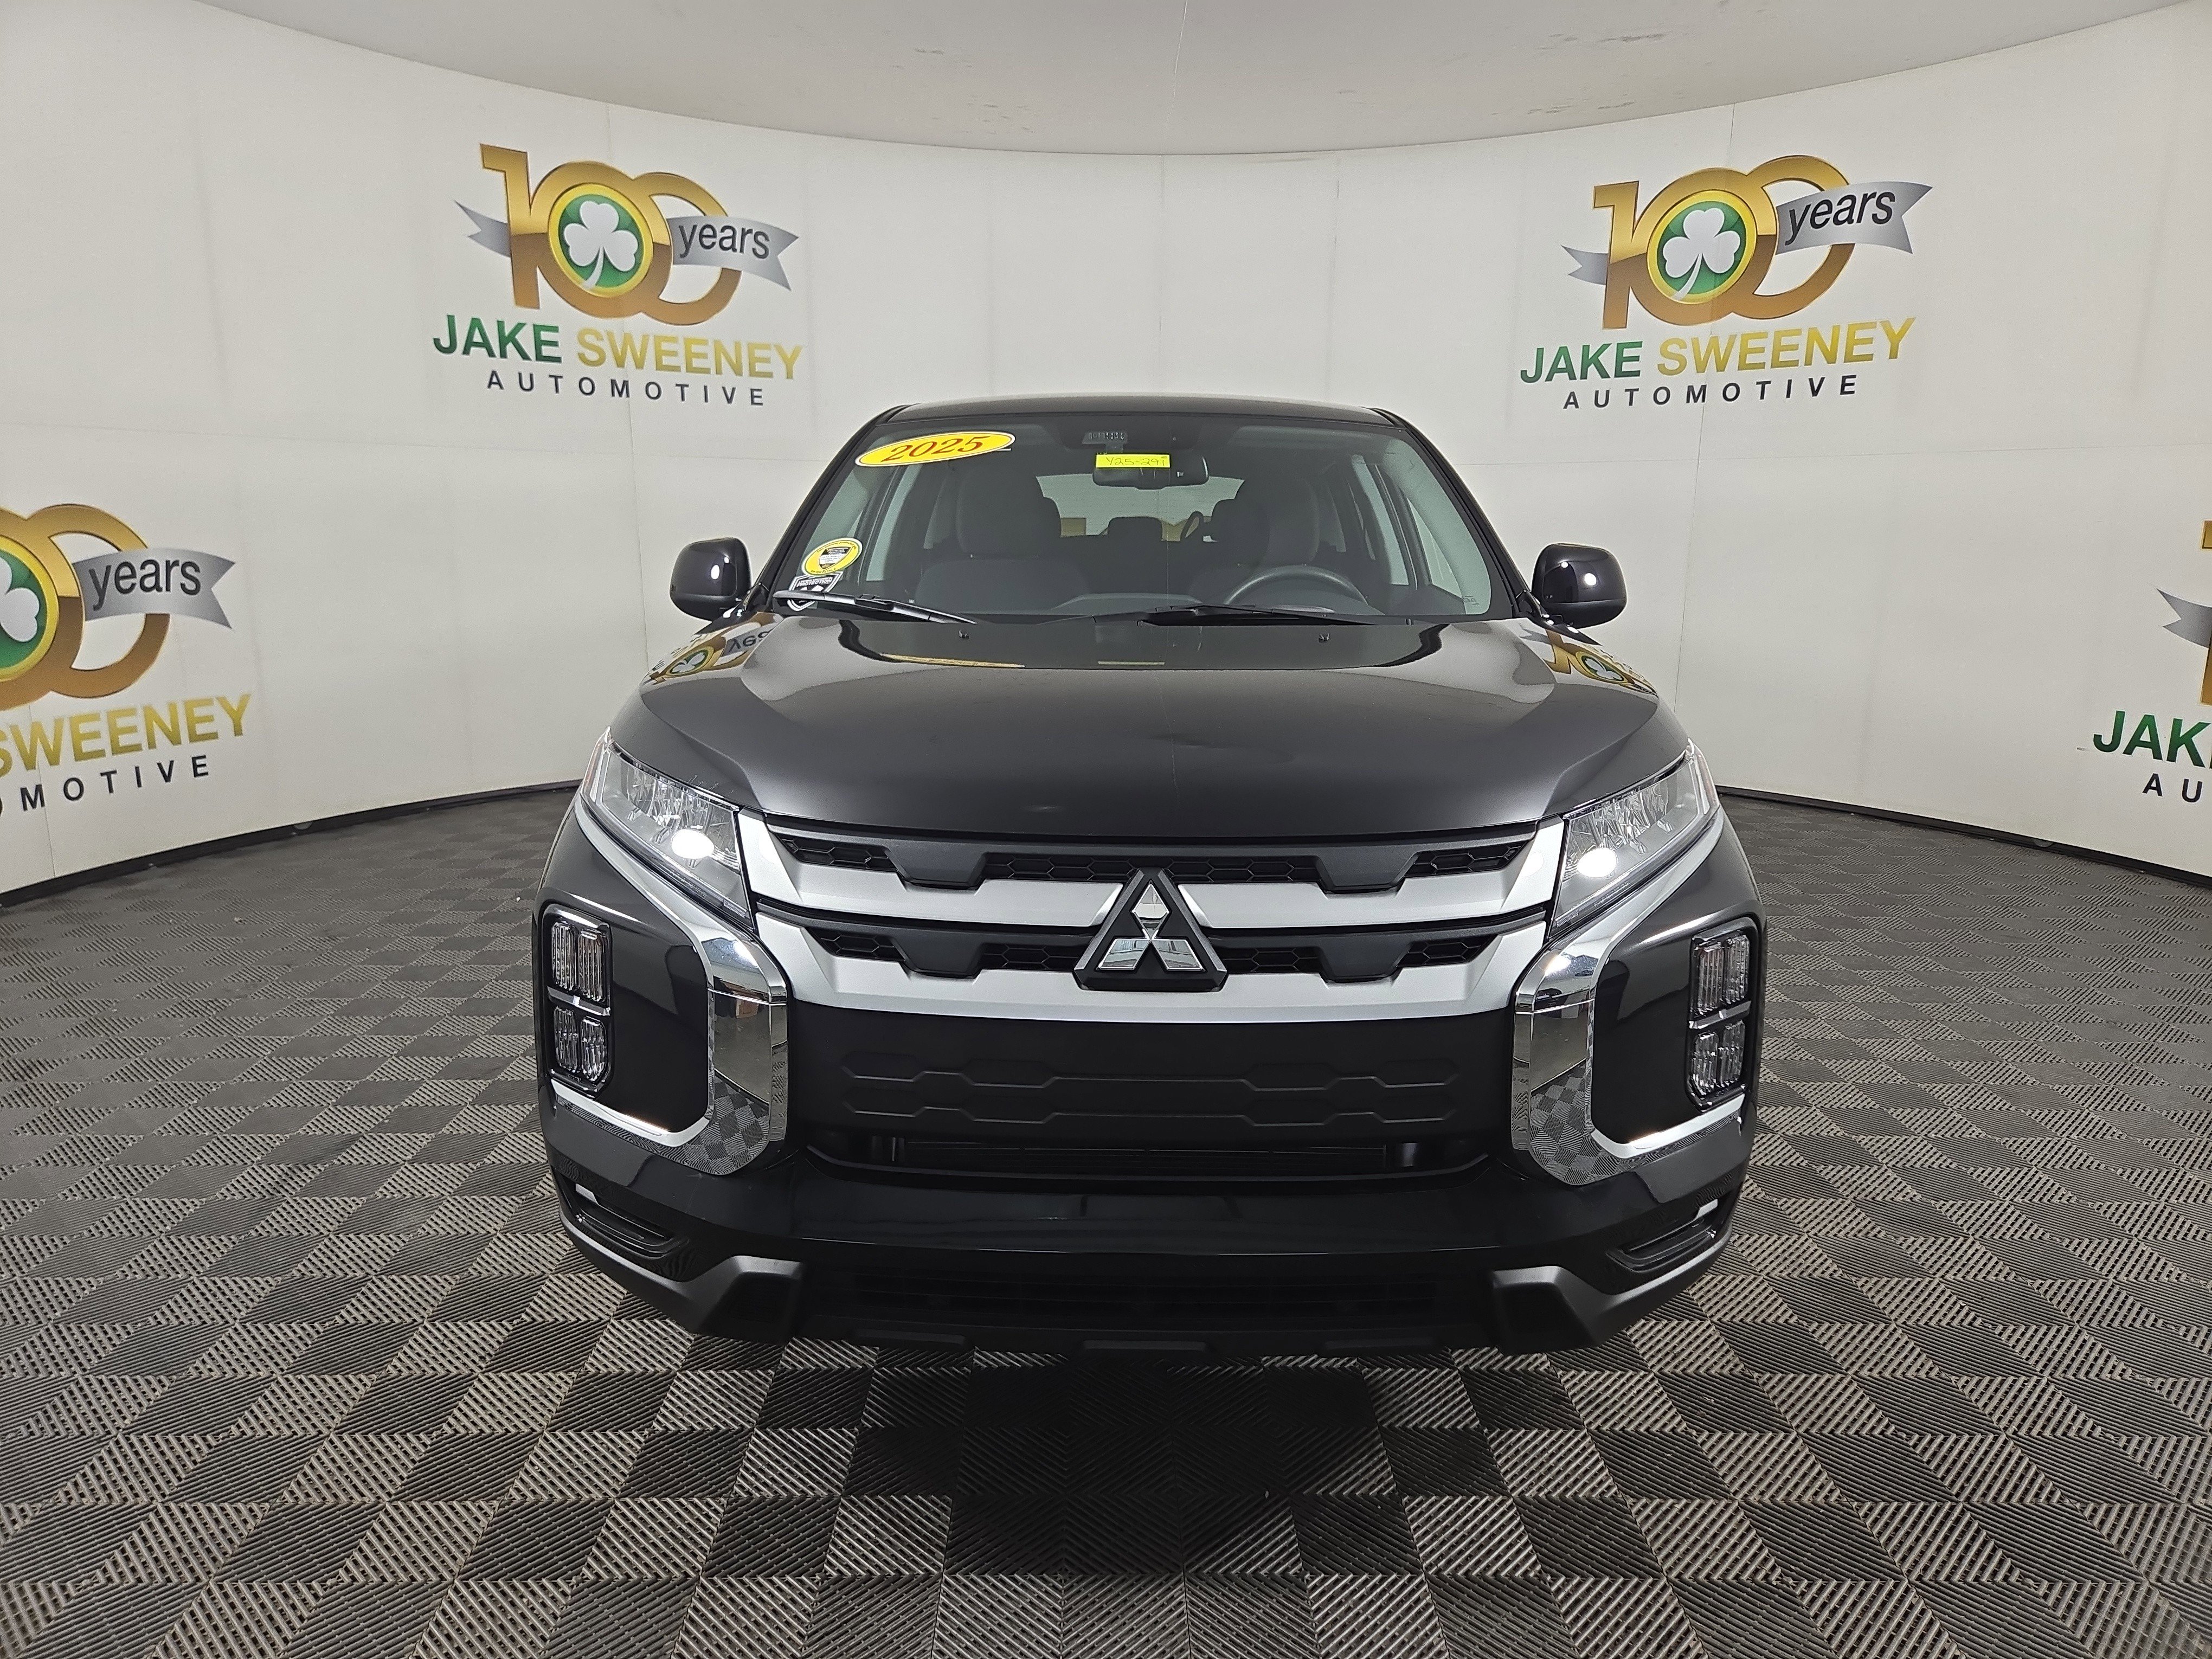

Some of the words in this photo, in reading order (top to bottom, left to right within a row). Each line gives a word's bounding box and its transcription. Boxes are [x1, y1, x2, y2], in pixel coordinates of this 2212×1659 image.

[679, 223, 770, 260] years
[1785, 190, 1895, 246] years
[434, 314, 562, 363] JAKE
[576, 328, 803, 380] SWEENEY
[1520, 341, 1643, 383] JAKE
[1657, 317, 1917, 376] SWEENEY
[487, 370, 764, 406] AUTOMOTIVE
[1563, 374, 1857, 409] AUTOMOTIVE
[880, 436, 991, 462] 2025
[89, 559, 202, 611] years
[2093, 710, 2212, 769] JAK
